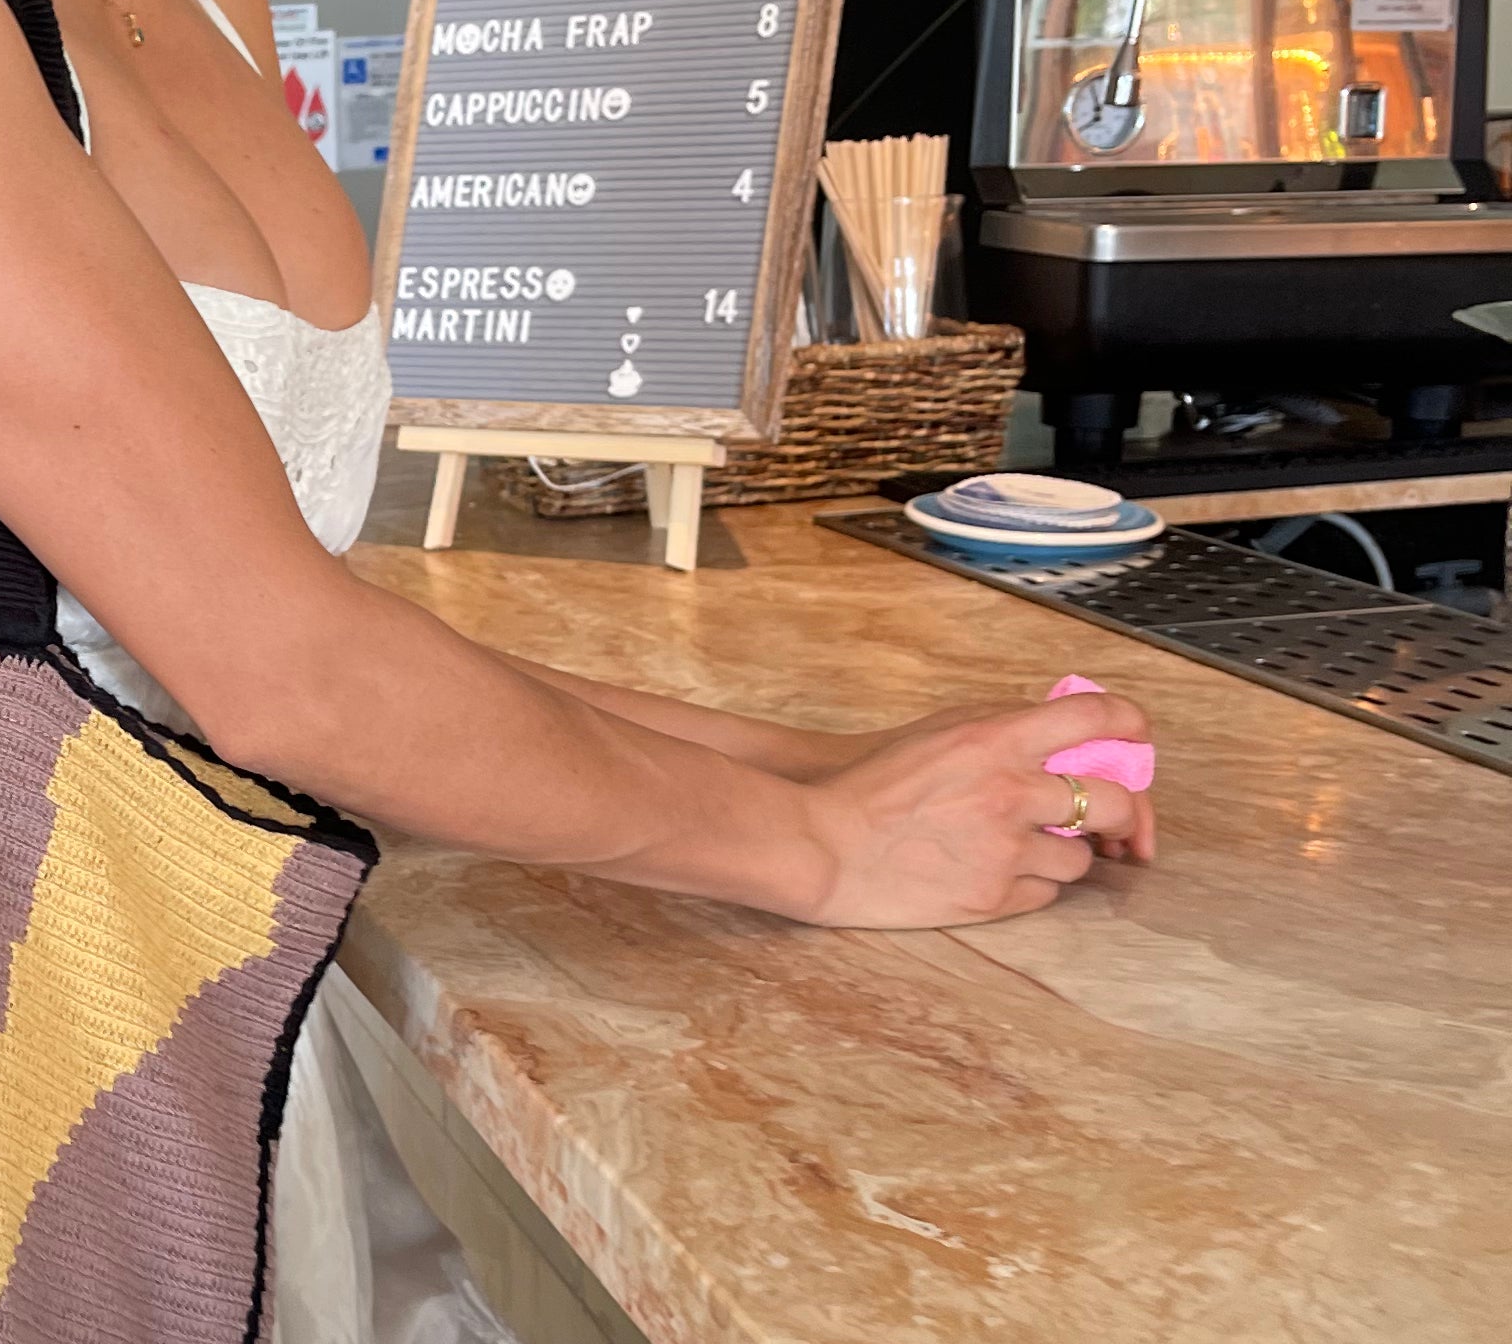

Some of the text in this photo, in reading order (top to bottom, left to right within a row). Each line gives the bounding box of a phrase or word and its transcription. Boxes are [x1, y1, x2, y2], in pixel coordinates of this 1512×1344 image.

[564, 10, 655, 51] FRAP
[756, 2, 780, 40] 8
[744, 78, 771, 116] 5
[730, 167, 757, 204] 4
[702, 287, 740, 325] 14
[390, 306, 533, 345] MARTINI
